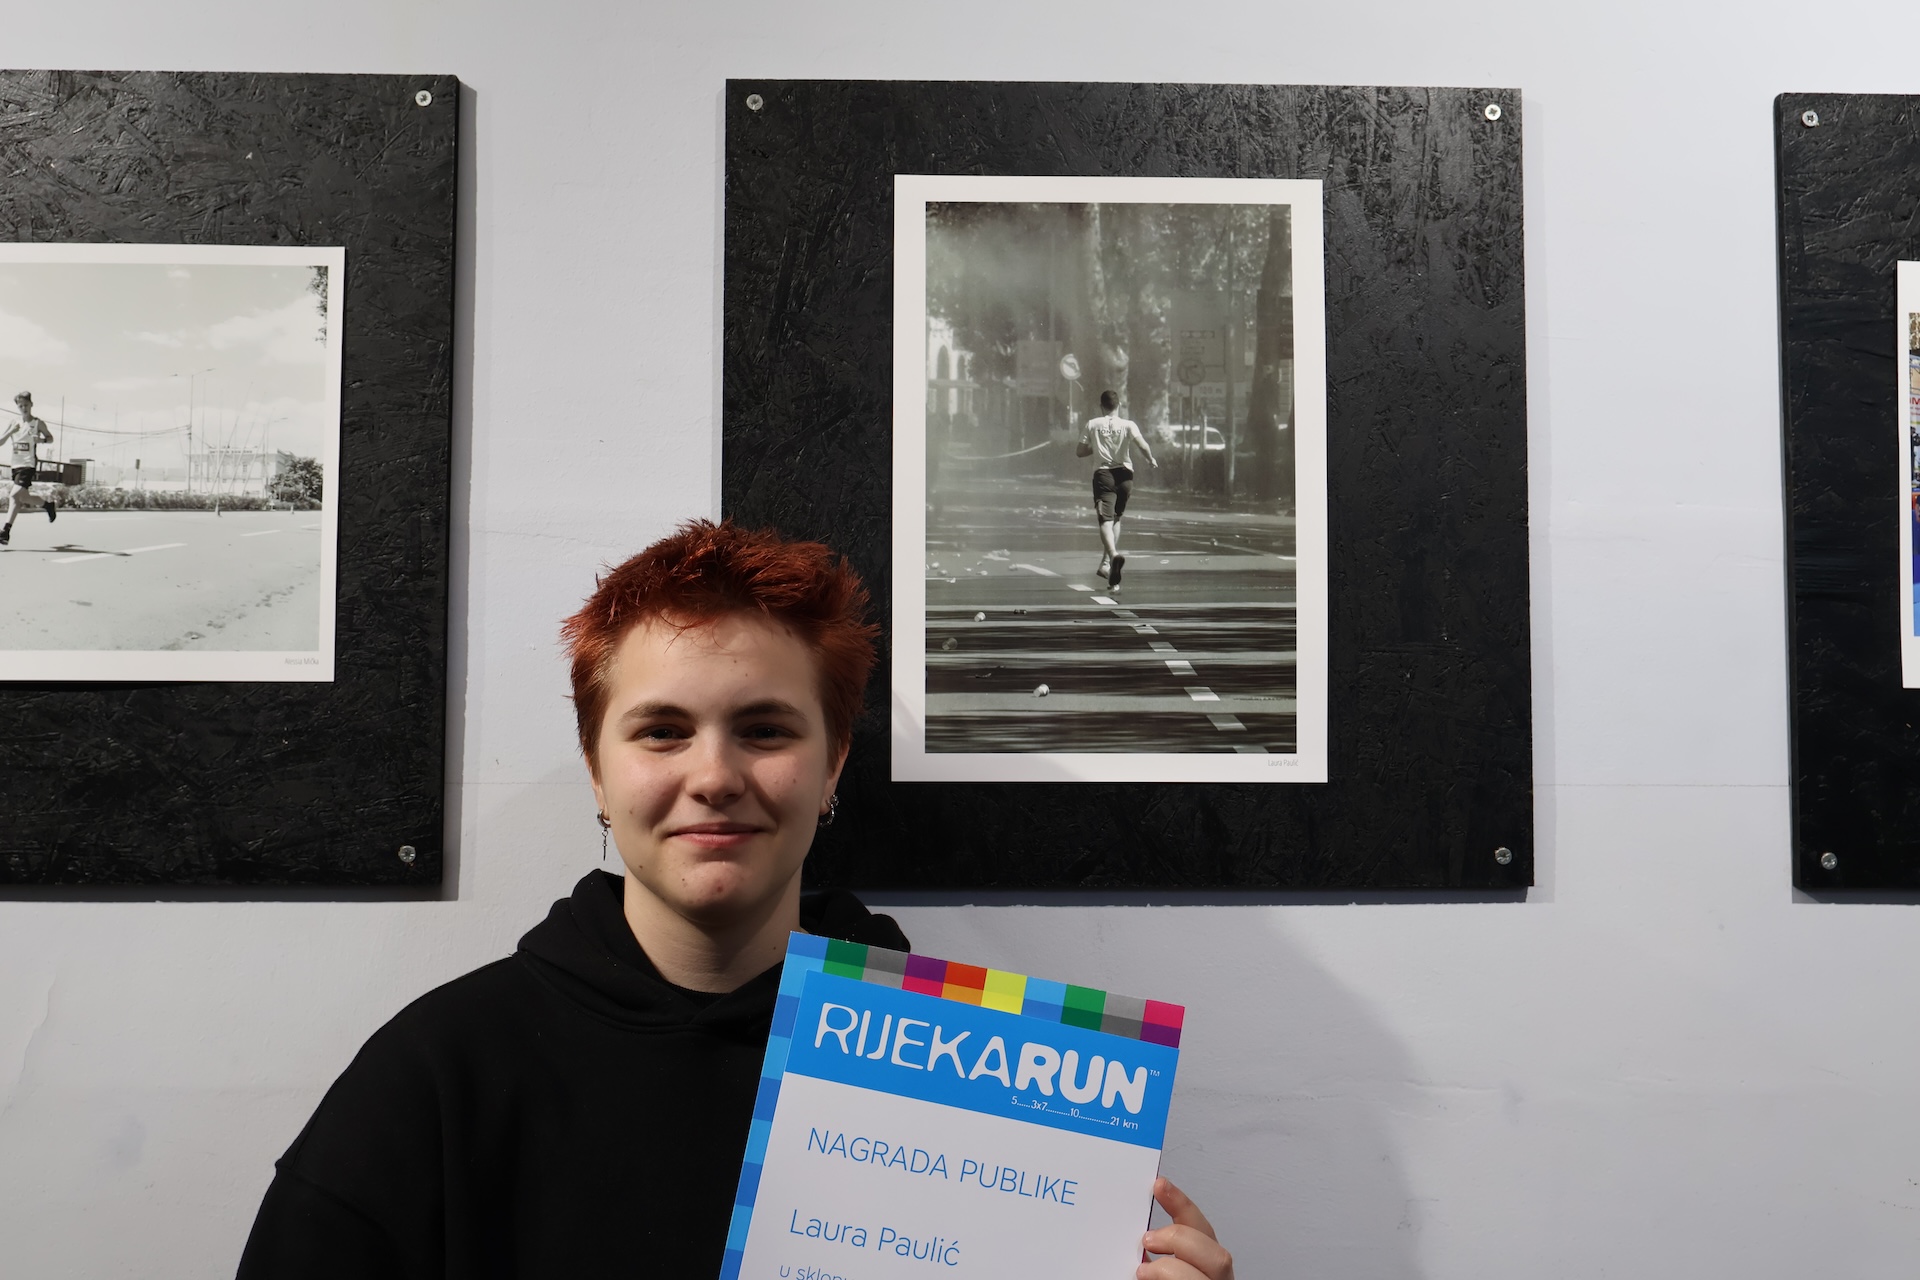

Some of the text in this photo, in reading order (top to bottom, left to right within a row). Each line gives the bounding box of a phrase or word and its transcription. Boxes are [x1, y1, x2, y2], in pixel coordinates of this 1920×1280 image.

[1123, 1119, 1139, 1130] km
[808, 1128, 1078, 1205] NAGRADA PUBLIKE
[790, 1209, 960, 1266] Laura Paulić
[779, 1265, 791, 1278] u
